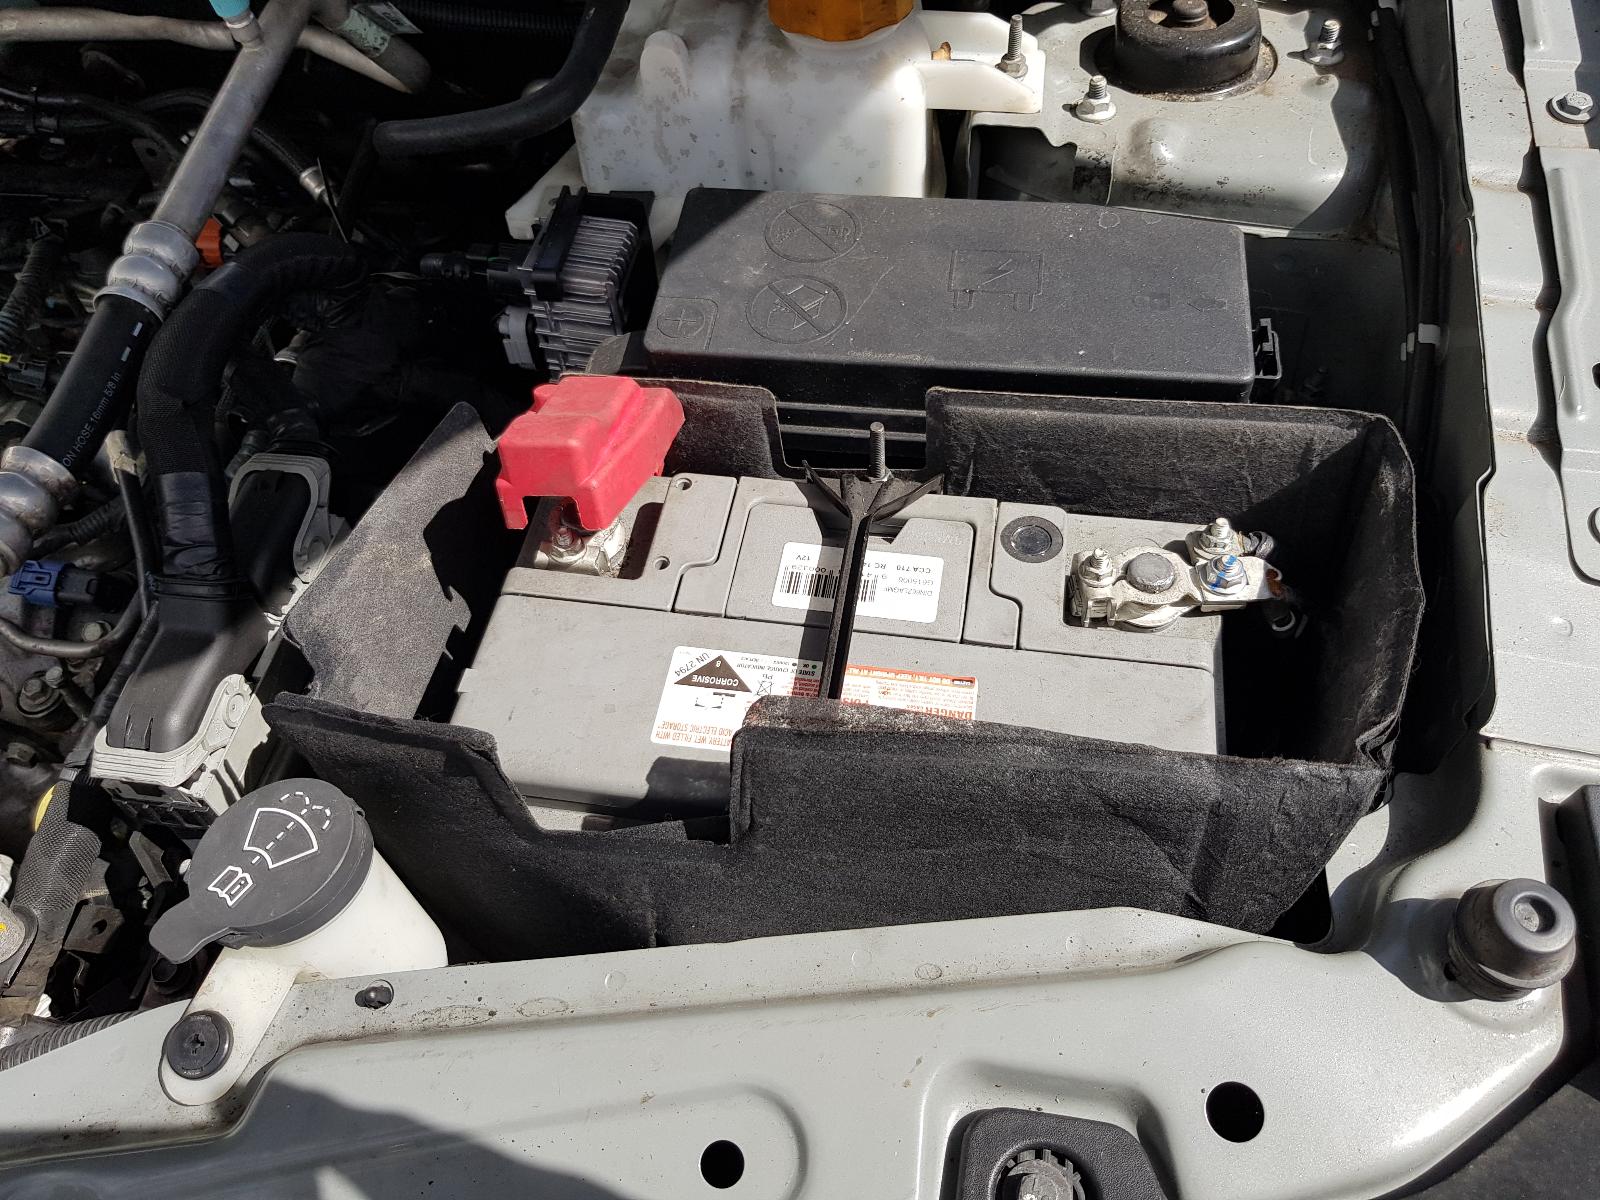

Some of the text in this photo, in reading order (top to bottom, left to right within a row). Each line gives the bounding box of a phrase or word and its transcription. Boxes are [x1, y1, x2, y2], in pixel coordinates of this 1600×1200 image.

[72, 423, 94, 452] HOSE
[90, 397, 110, 423] 16mm
[874, 562, 886, 570] RC
[674, 652, 710, 677] UN 2794
[715, 660, 722, 668] 8
[798, 669, 816, 677] STATE
[691, 674, 739, 687] CORROSIVE
[690, 724, 718, 735] ELECTRIC
[655, 730, 671, 740] WITH
[672, 732, 692, 742] FILLED
